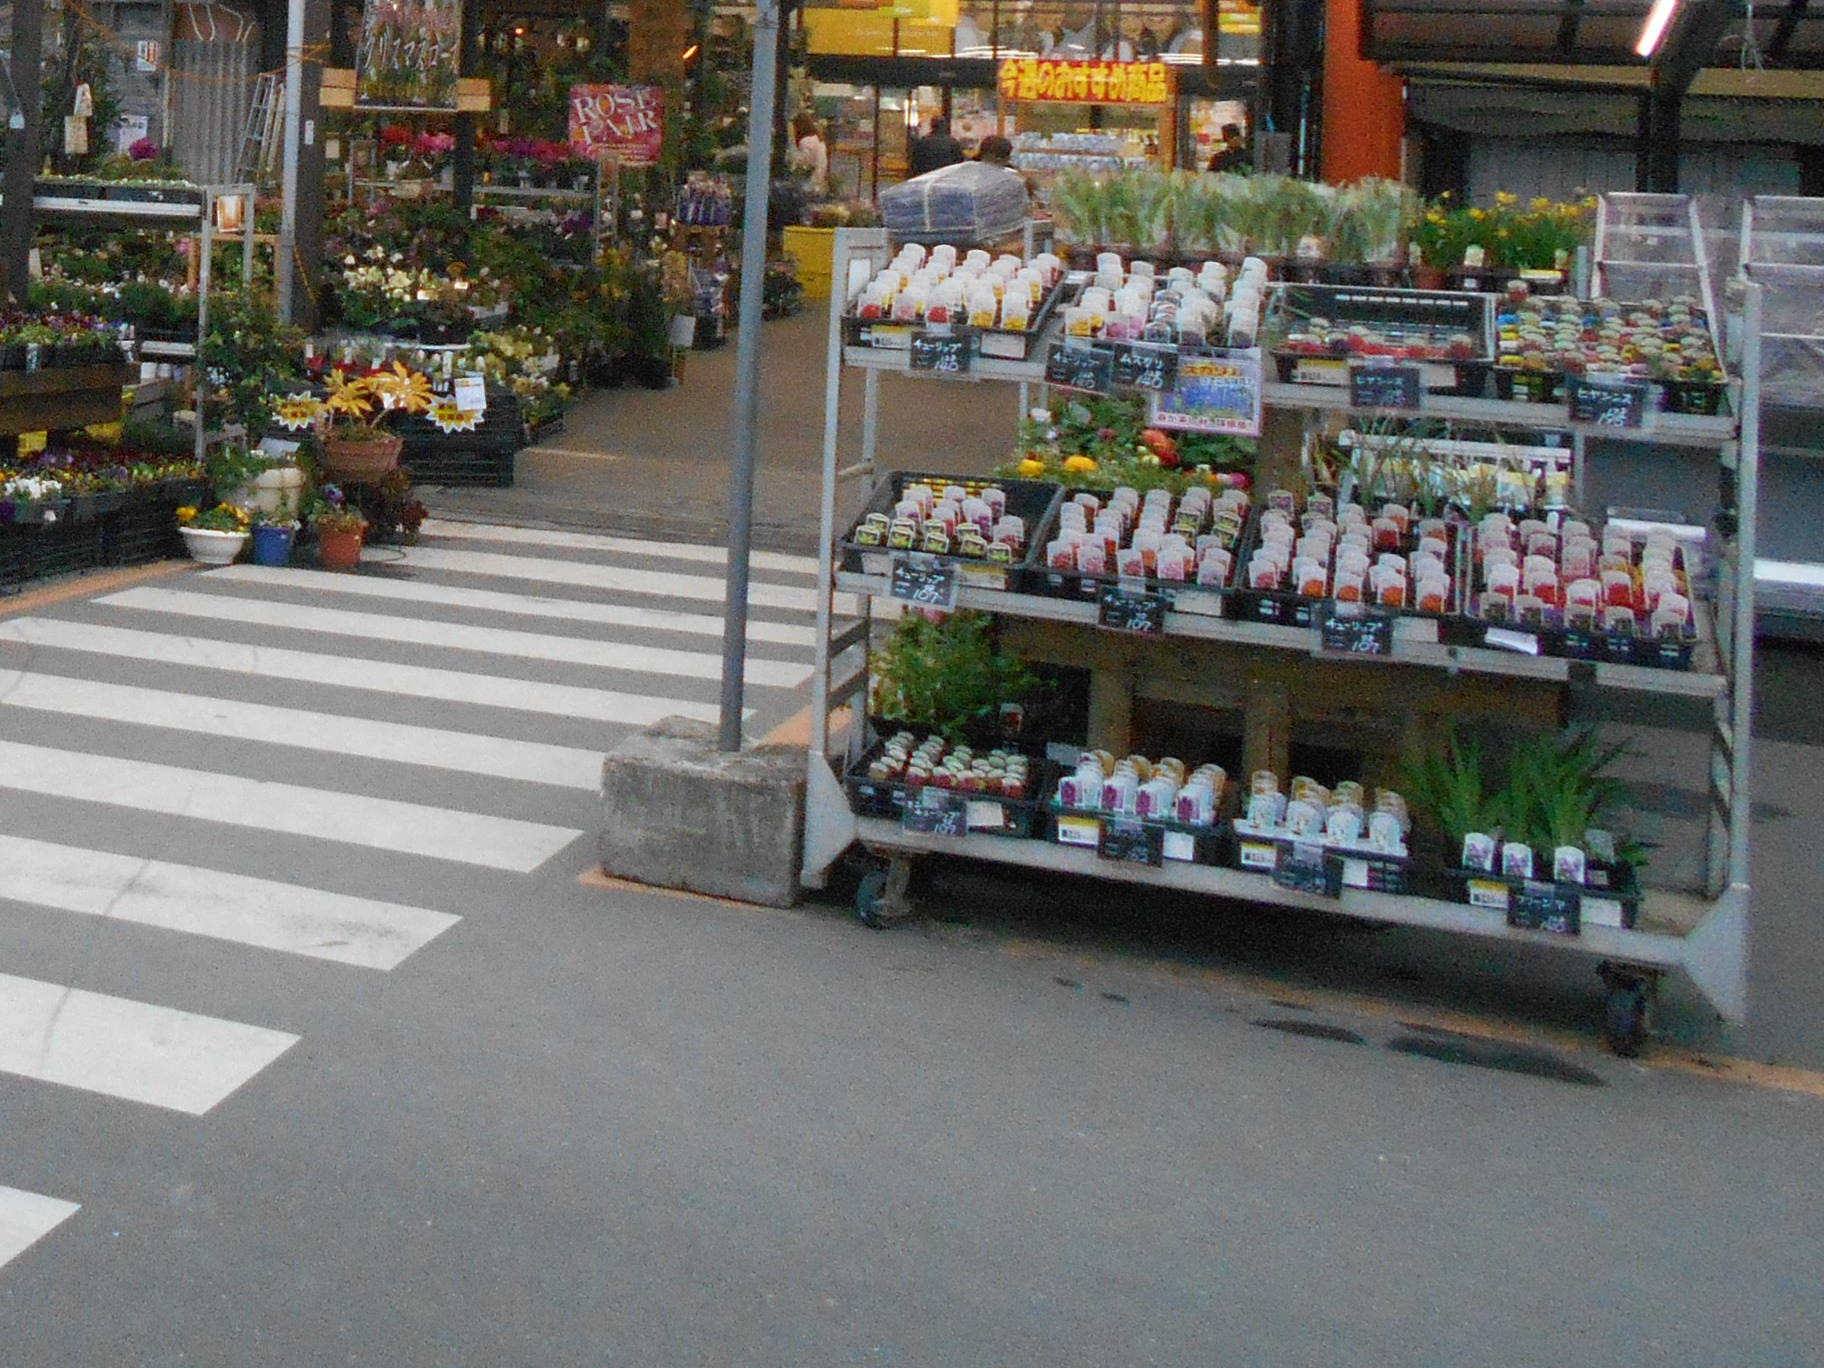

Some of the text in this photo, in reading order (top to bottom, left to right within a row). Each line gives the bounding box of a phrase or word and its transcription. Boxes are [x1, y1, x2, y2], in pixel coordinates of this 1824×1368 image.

[999, 59, 1169, 103] 今週のおすすめ商品
